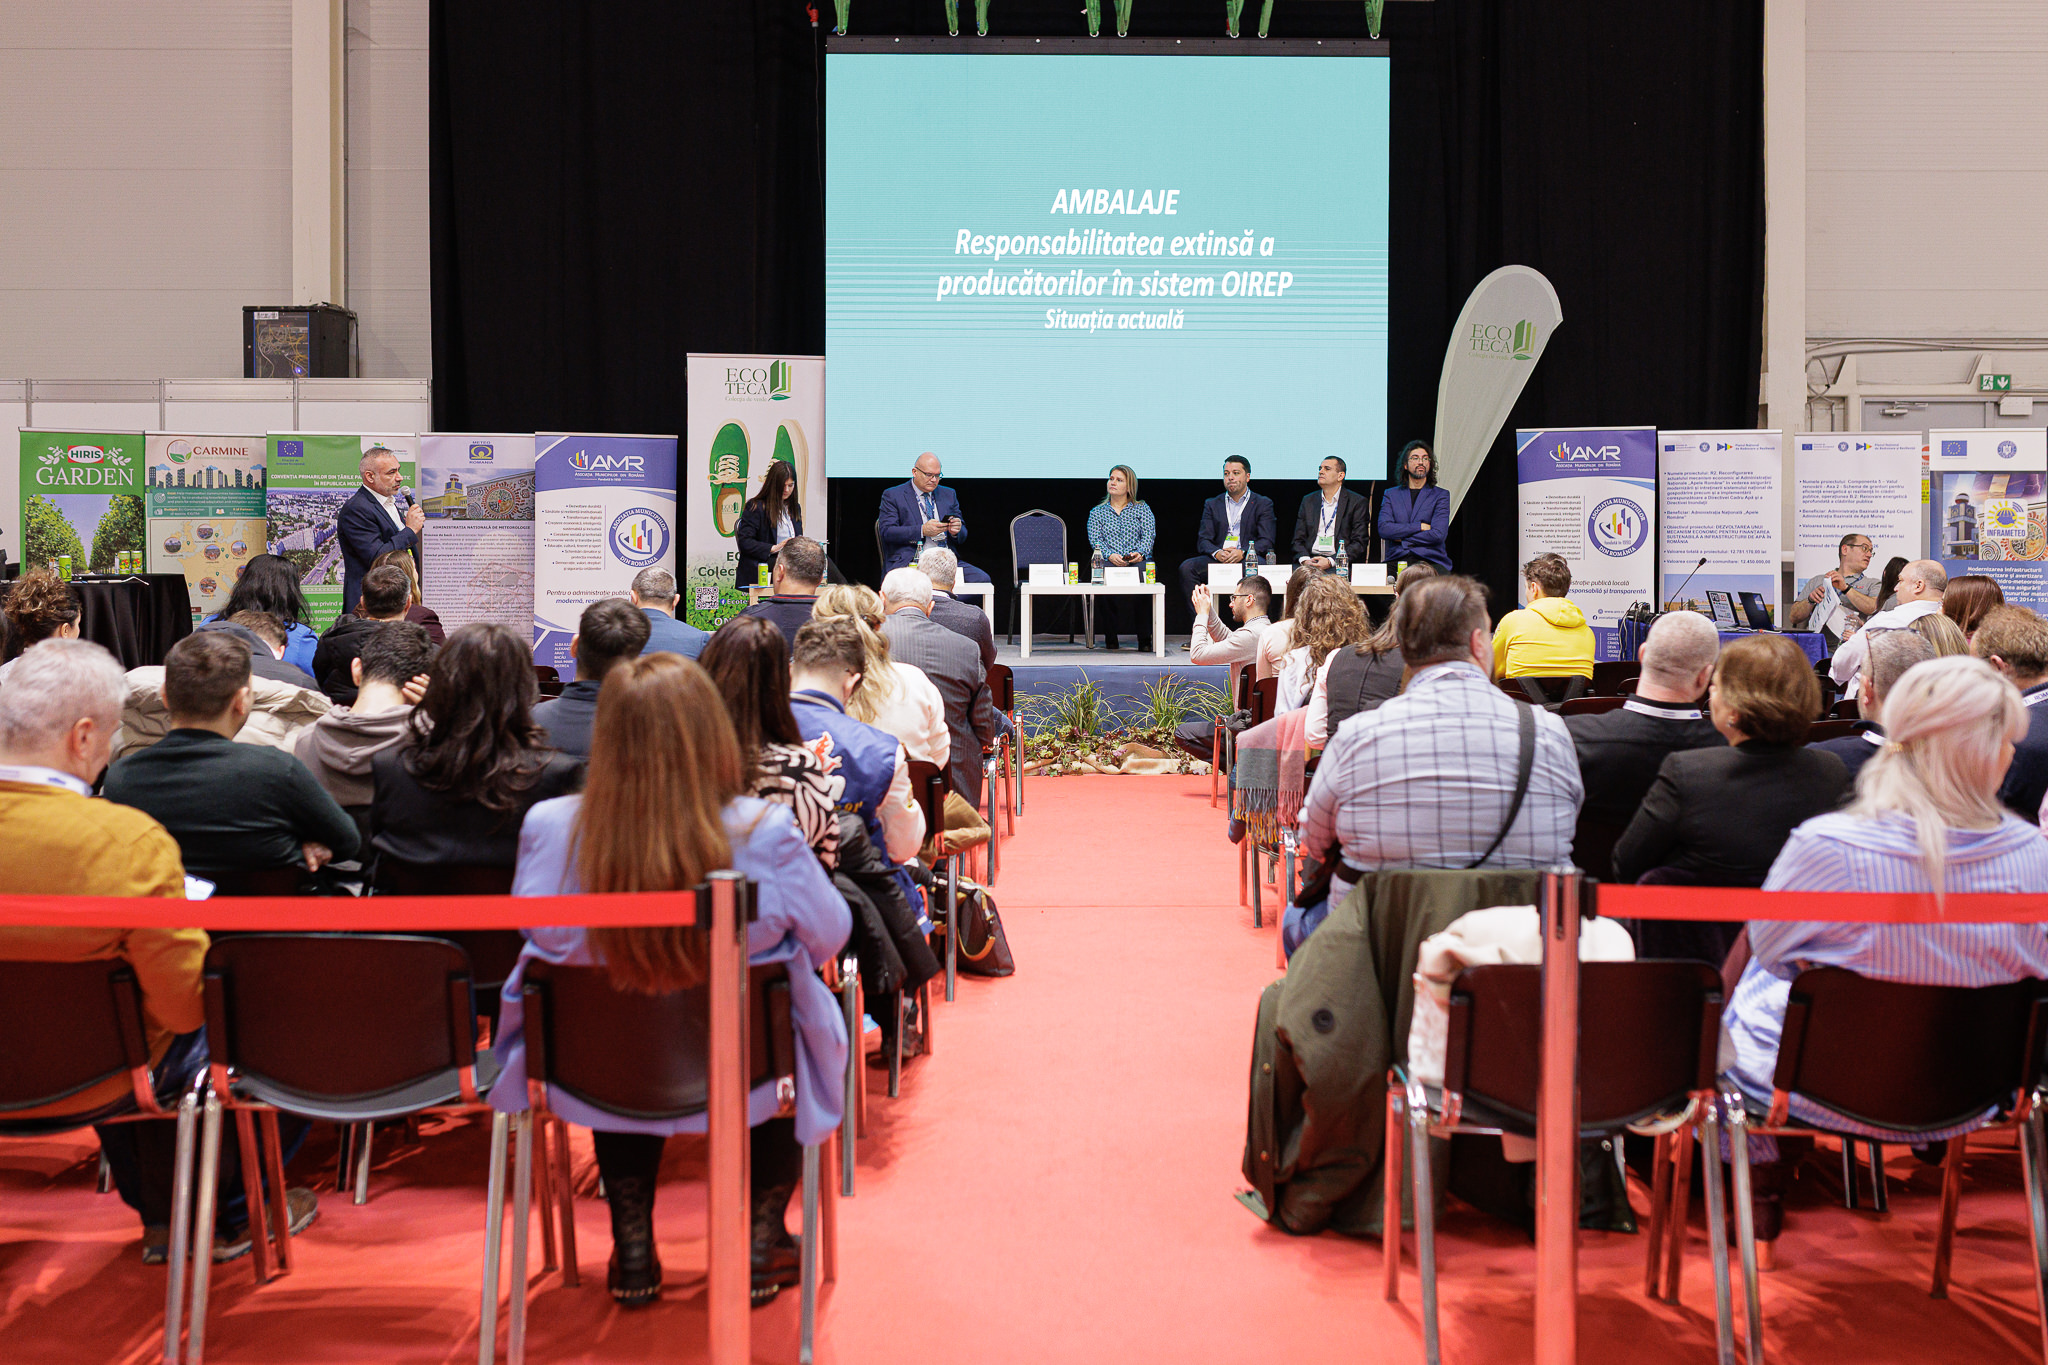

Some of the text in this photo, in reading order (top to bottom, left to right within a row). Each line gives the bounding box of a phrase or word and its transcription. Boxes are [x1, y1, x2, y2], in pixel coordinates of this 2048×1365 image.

[1050, 189, 1180, 214] AMBALAJE
[955, 228, 1274, 261] Responsabilitatea extinsă a
[936, 268, 1293, 301] producătorilor în sistem OIREP
[1045, 309, 1184, 333] Situația actuală
[1470, 324, 1511, 340] ECO
[1469, 339, 1510, 353] TECA
[726, 368, 767, 382] ECO
[725, 383, 767, 394] TECA
[71, 450, 101, 458] HIRIS
[193, 446, 248, 456] CARMINE
[1570, 446, 1621, 460] AMR
[590, 455, 644, 471] AMR
[36, 467, 134, 485] GARDEN
[1987, 529, 2025, 537] INFRAMETEO
[1599, 546, 1636, 556] DIN ROMÂNIA
[620, 556, 657, 566] DIN ROMÂNIA
